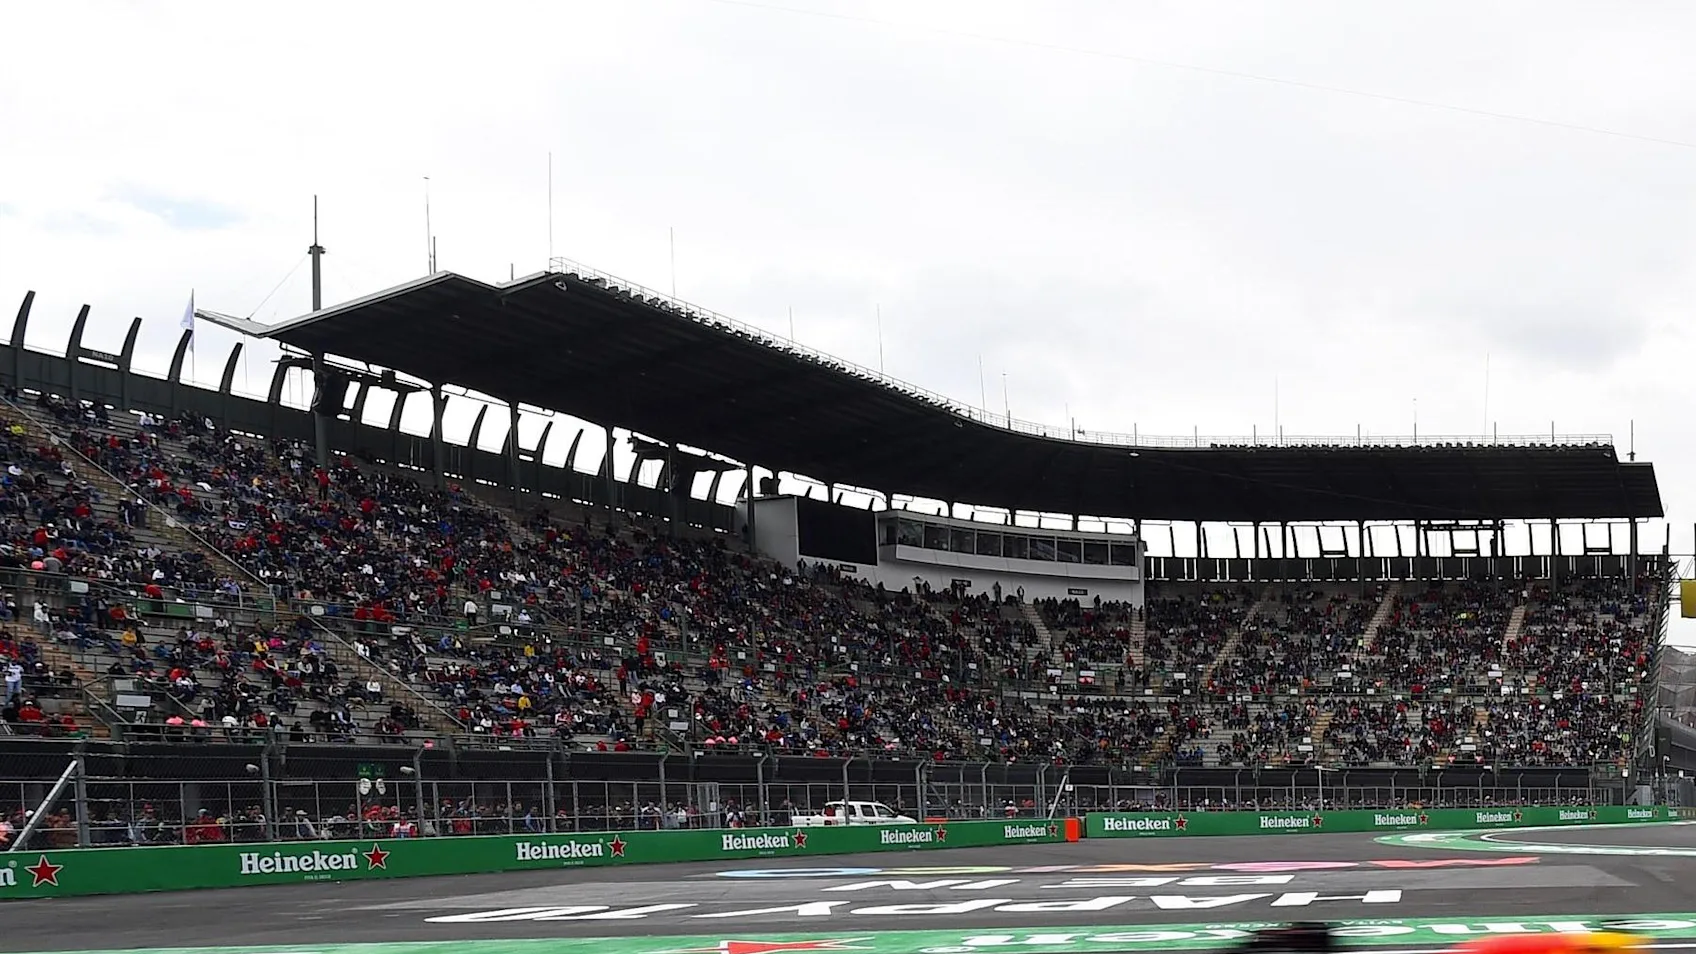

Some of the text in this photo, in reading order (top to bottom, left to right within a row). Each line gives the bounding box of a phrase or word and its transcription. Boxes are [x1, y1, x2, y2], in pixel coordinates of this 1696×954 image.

[1104, 817, 1170, 831] Heineken
[1260, 815, 1310, 828] Heineken
[1375, 813, 1417, 826] Heineken
[1476, 811, 1513, 823] Heineken
[880, 828, 932, 844] Heineken
[1004, 823, 1049, 838] Heineken
[722, 833, 789, 850] Heineken
[516, 839, 603, 861] Heineken
[240, 850, 358, 875] Heineken
